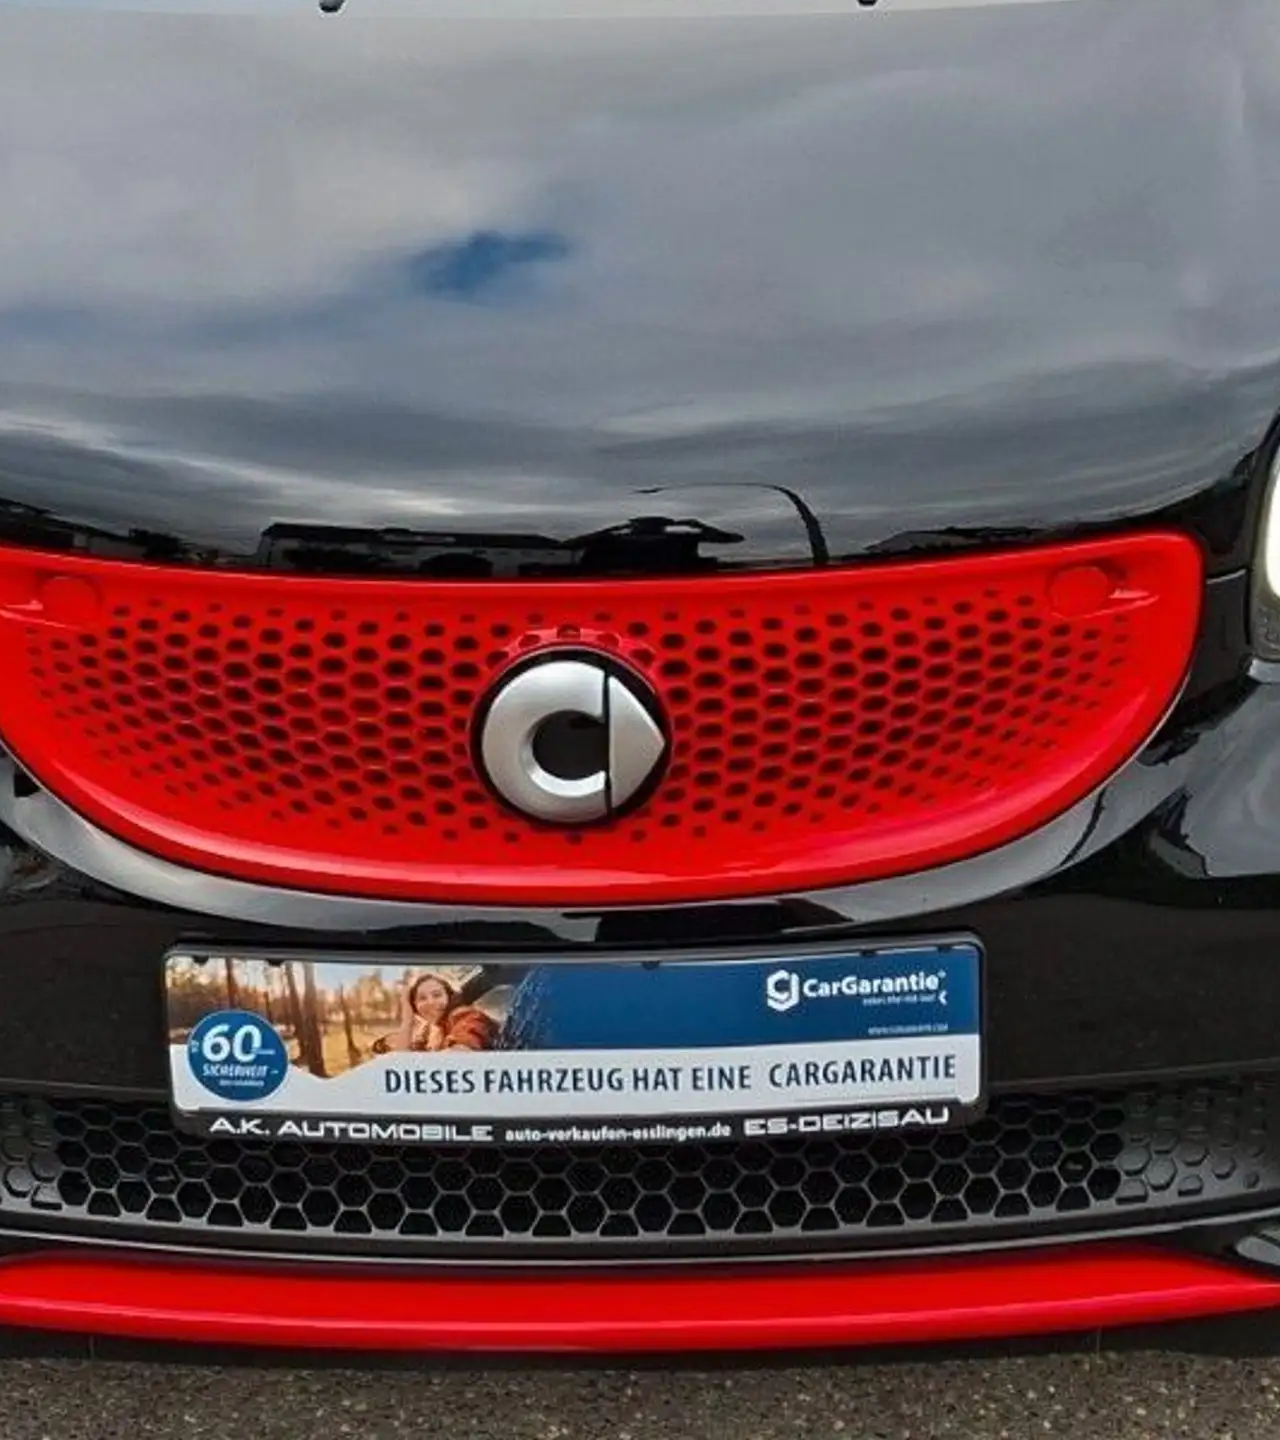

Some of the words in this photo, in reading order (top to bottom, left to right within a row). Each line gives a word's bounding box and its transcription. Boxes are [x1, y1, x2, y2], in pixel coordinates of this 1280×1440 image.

[202, 1023, 263, 1063] 60
[384, 1067, 475, 1094] DIESES
[483, 1066, 624, 1093] FAHRZEUG
[632, 1066, 683, 1093] HAT
[691, 1064, 752, 1091] EINE
[768, 1053, 958, 1088] CARGARANTIE
[208, 1116, 271, 1137] A.K.
[276, 1119, 494, 1142] AUTOMOBILE
[505, 1120, 733, 1143] auto-verkaufen-esslingen.de
[743, 1105, 950, 1138] ES-DEIZISAU
